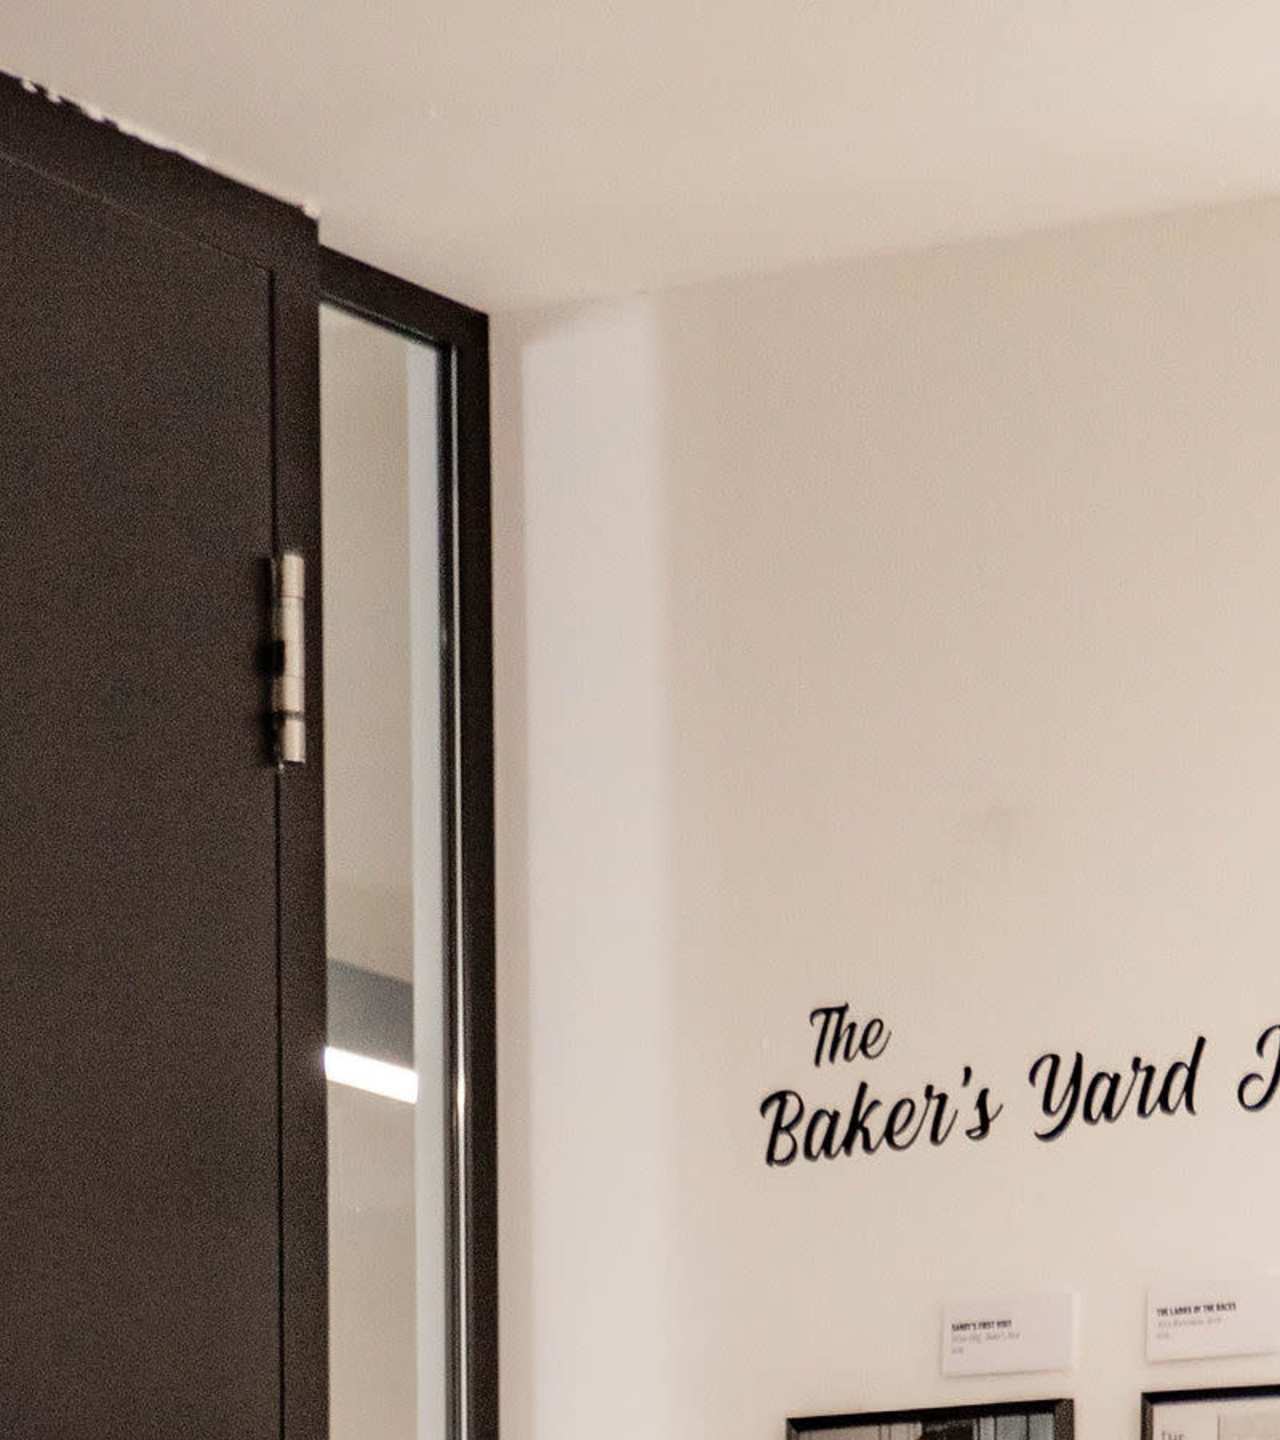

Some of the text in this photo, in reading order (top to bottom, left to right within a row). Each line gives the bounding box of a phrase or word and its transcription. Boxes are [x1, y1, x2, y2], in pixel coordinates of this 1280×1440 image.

[809, 1002, 891, 1067] The
[759, 1065, 1004, 1167] Baker's
[1028, 1035, 1207, 1142] Yard
